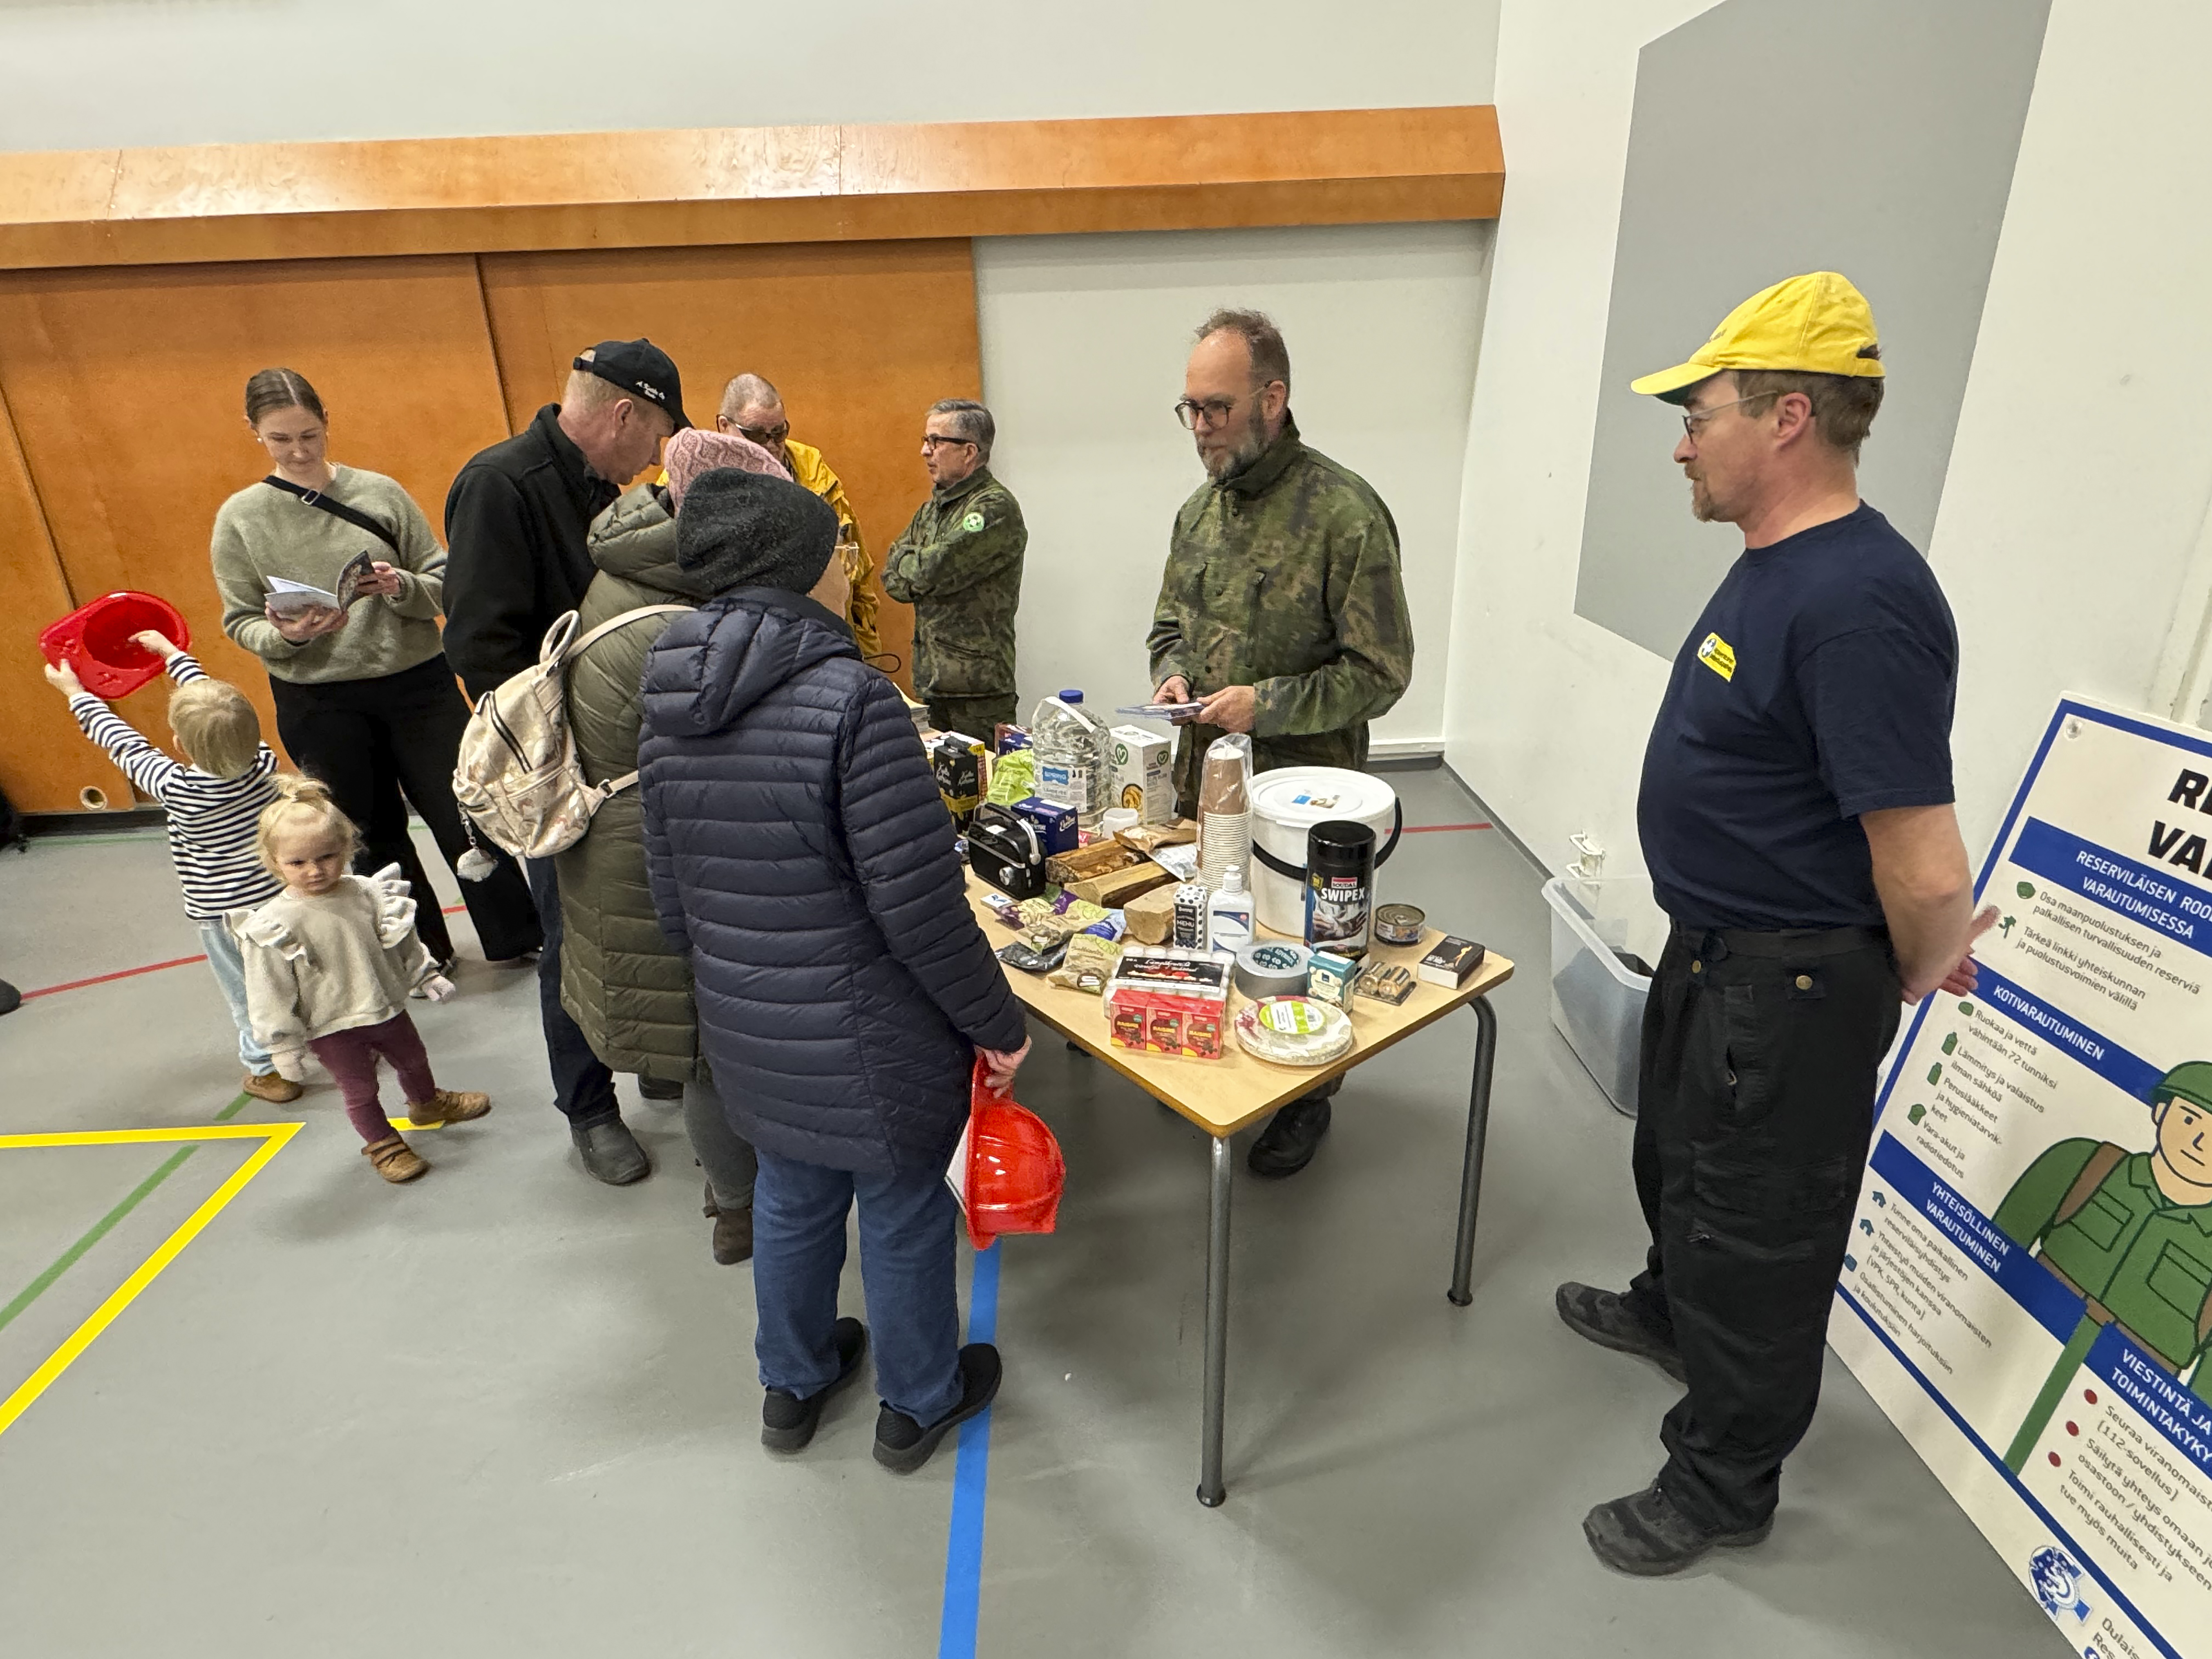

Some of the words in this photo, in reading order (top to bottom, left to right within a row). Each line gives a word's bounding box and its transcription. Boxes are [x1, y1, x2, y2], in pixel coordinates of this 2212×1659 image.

[2167, 768, 2212, 816] R
[2148, 820, 2212, 881] VA
[1321, 887, 1365, 902] SWIPEX
[2076, 851, 2177, 904] RESERVILÄISEN
[2179, 896, 2212, 923] ROO
[2083, 876, 2194, 939] VARAUTUMISESSA
[2033, 905, 2082, 935] paikallisen
[2083, 929, 2154, 971] turvallisuuden
[2154, 967, 2201, 995] reserviä
[2040, 891, 2057, 906] Osa
[2058, 902, 2149, 952] maanpuolustuksen
[2148, 946, 2162, 958] ja
[2015, 938, 2026, 949] ja
[2026, 945, 2107, 994] puolustusvoimien
[2109, 989, 2138, 1011] välillä
[2024, 926, 2052, 948] Tärkeä
[2052, 942, 2078, 962] linkki
[2077, 958, 2146, 999] yhteiskunnan
[1975, 1009, 2005, 1035] Ruokaa
[2004, 1029, 2013, 1040] ja
[2015, 1036, 2038, 1056] vettä
[1993, 985, 2105, 1060] KOTIVARAUTUMINEN
[1951, 1060, 1972, 1081] ilman
[1973, 1077, 2003, 1102] sähköä
[1957, 1046, 1997, 1078] Lämmitys
[1994, 1074, 2005, 1085] ja
[2006, 1081, 2044, 1113] valaistus
[1969, 1025, 2008, 1057] vähintään
[2008, 1051, 2021, 1065] 72
[2021, 1061, 2058, 1089] tunniksi
[1931, 1104, 1948, 1122] keet
[1935, 1090, 1945, 1101] ja
[1945, 1097, 2002, 1145] hygieniatarvik-
[1944, 1078, 1998, 1123] Peruslääkkeet
[1917, 1136, 1964, 1178] radiotiedotus
[1923, 1120, 1957, 1154] Vara-akut
[1955, 1148, 1966, 1160] ja
[1891, 1203, 1911, 1226] Tunne
[1911, 1225, 1927, 1242] oma
[1926, 1199, 2001, 1273] VARAUTUMINEN
[1932, 1181, 2010, 1256] YHTEISÖLLINEN
[2123, 1348, 2194, 1418] VIESTINTÄ
[2192, 1414, 2212, 1435] JA
[2106, 1406, 2143, 1444] Seuraa
[2145, 1442, 2212, 1512] viranomaist
[2060, 1484, 2077, 1505] tue
[2077, 1504, 2106, 1536] myös
[2106, 1535, 2138, 1570] muita
[2068, 1469, 2095, 1501] Toimi
[2094, 1498, 2162, 1569] rauhallisesti
[2158, 1565, 2173, 1582] ja
[2078, 1454, 2126, 1504] osastoon
[2132, 1508, 2212, 1591] yhdistykseen
[2087, 1438, 2123, 1477] Säilytä
[2121, 1475, 2162, 1516] yhteys
[2163, 1515, 2203, 1557] omaan
